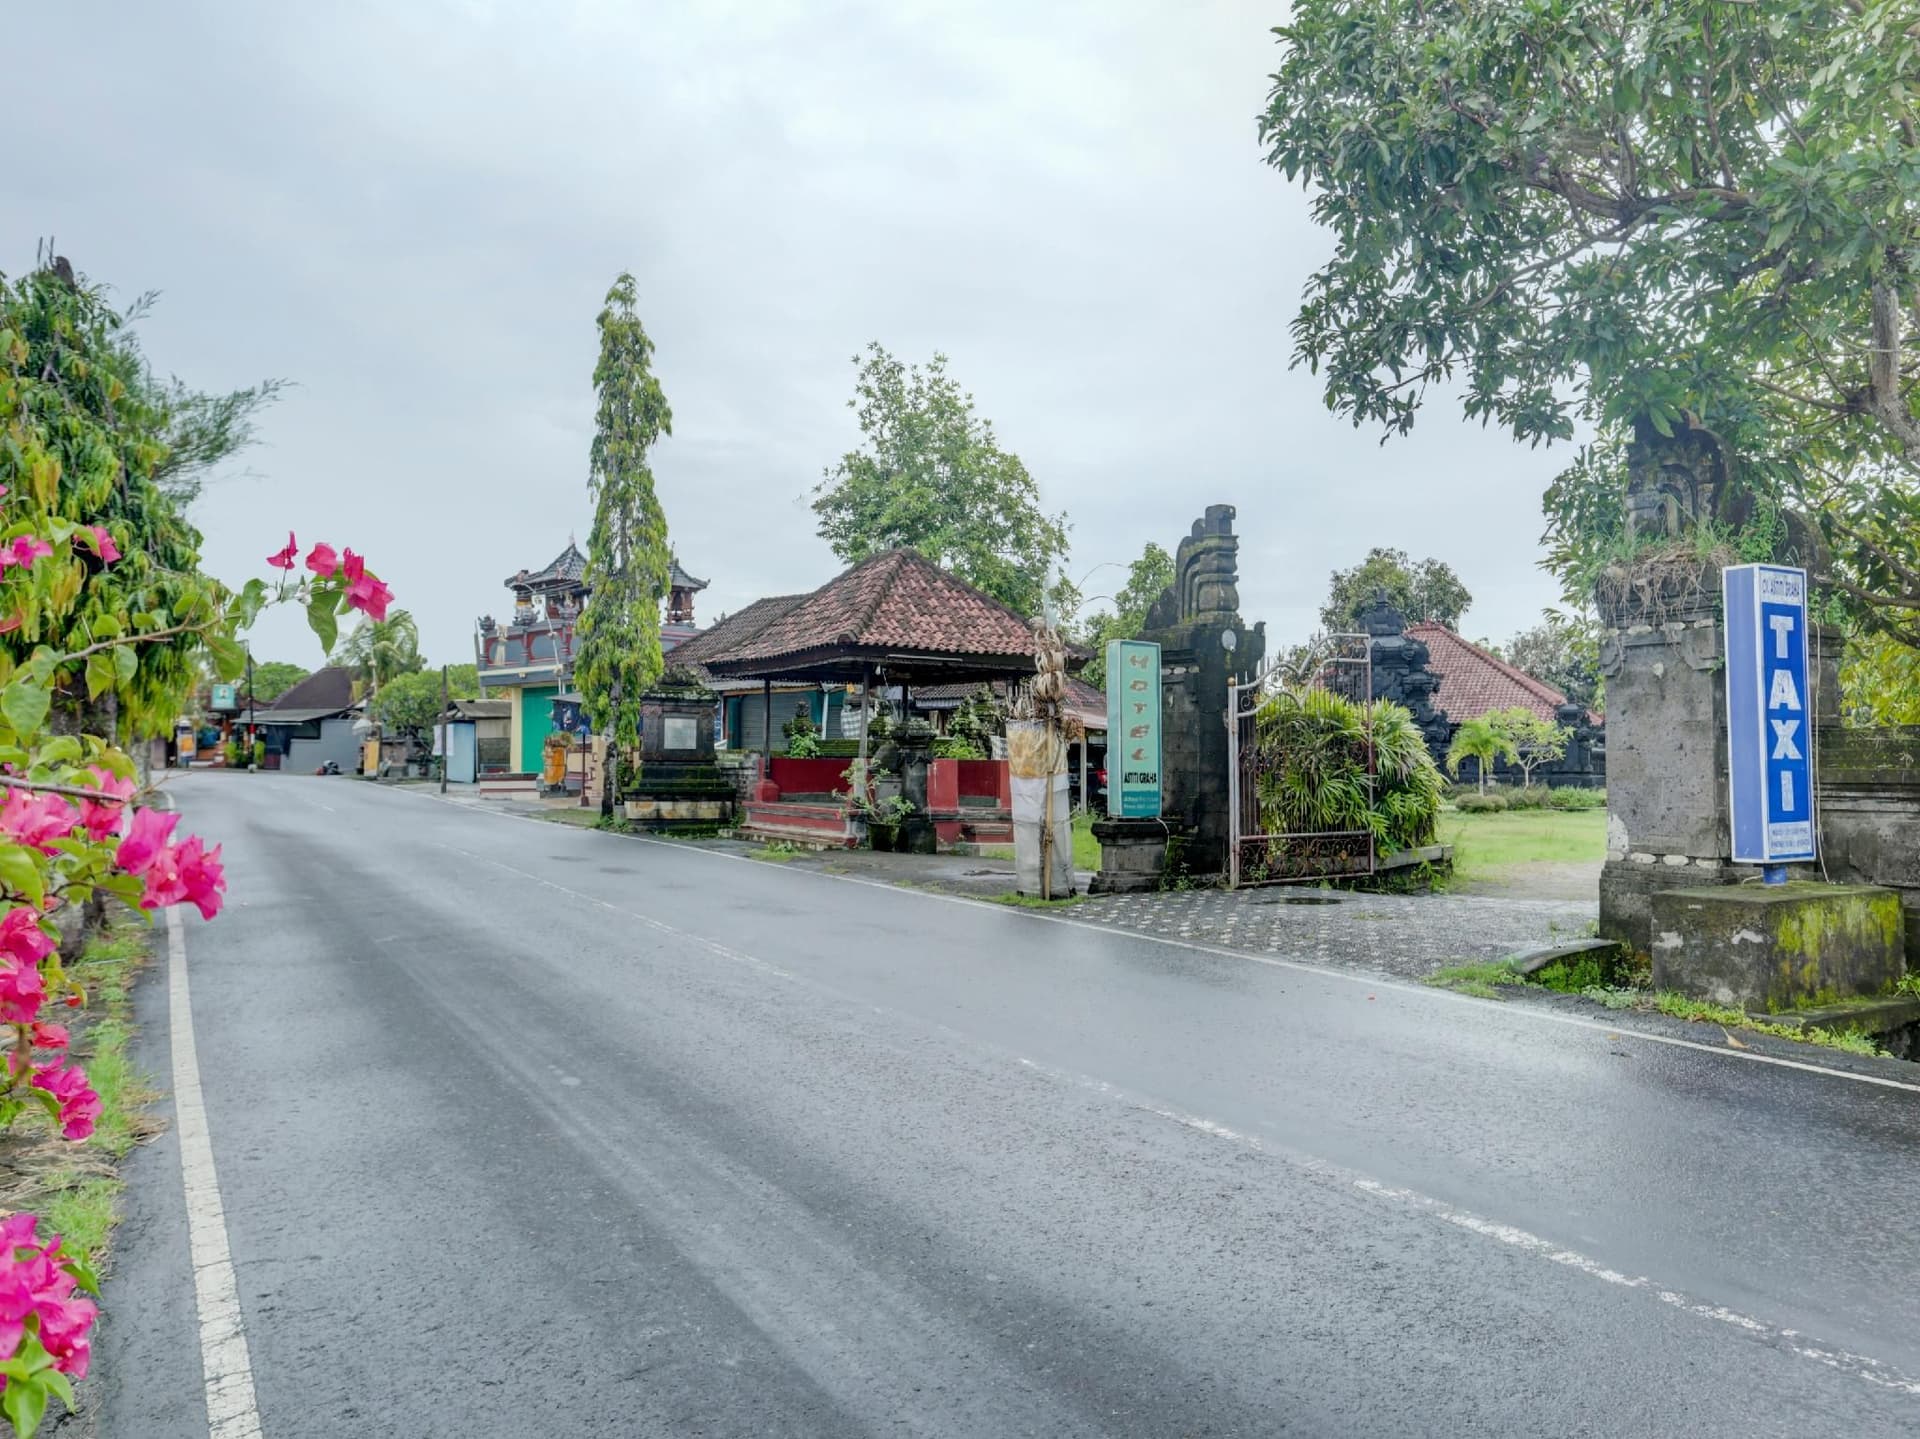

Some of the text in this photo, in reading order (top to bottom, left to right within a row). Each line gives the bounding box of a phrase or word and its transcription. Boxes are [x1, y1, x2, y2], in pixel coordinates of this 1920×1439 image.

[1129, 655, 1150, 760] HOTEL
[1769, 614, 1803, 812] TAXI
[1124, 772, 1157, 784] ASTITI GRAHA
